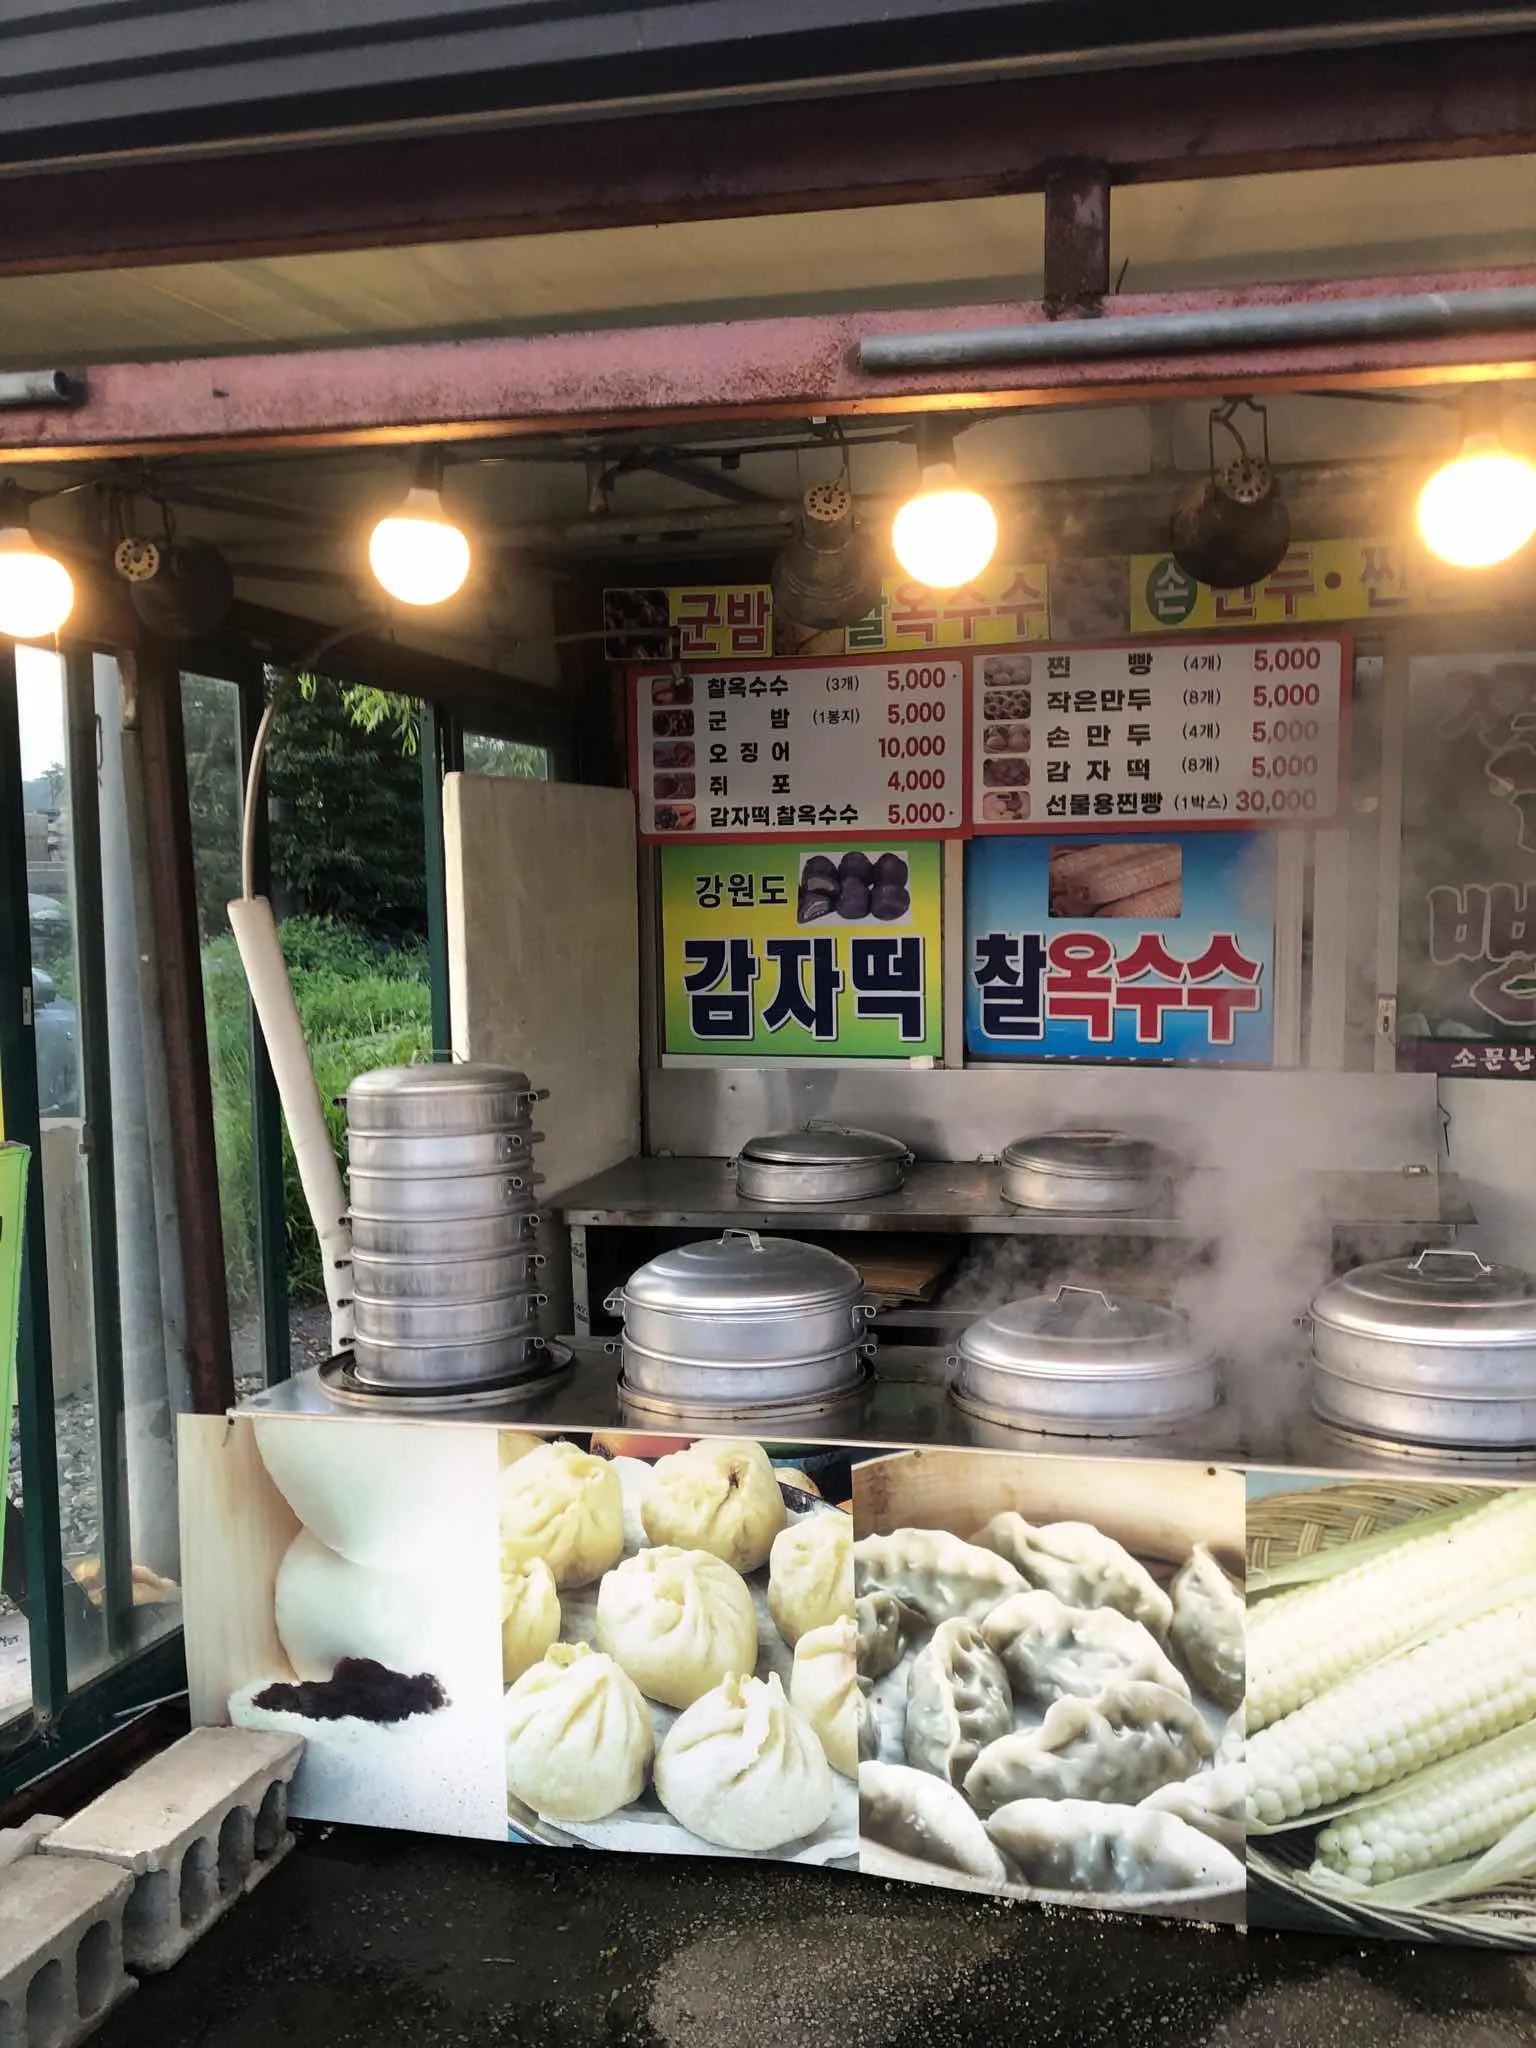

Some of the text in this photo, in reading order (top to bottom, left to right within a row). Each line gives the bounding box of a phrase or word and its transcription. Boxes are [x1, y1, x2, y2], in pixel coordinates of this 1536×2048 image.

[676, 590, 772, 656] 군밤
[1183, 654, 1222, 672] (4개)
[1254, 647, 1321, 672] 5,000
[707, 667, 946, 699] 찰옥수수 (3개) 5,000
[1047, 684, 1320, 713] 작은만두 (8개) 5,000
[812, 708, 860, 726] (1봉지)
[887, 702, 946, 725] 5,000
[1182, 722, 1221, 740] (4개)
[1252, 720, 1320, 744] 5,000
[878, 736, 946, 759] 10,000
[1182, 756, 1220, 774] (8개)
[1252, 755, 1319, 779] 5,000
[887, 769, 945, 793] 4,000
[888, 803, 946, 826] 5,000
[1046, 790, 1318, 817] 선물용찐빵 (1박스) 30,000
[696, 874, 788, 909] 강원도
[684, 936, 926, 1042] 감자떡
[973, 931, 1262, 1044] 찰옥수수
[1451, 1047, 1536, 1072] 소문난
